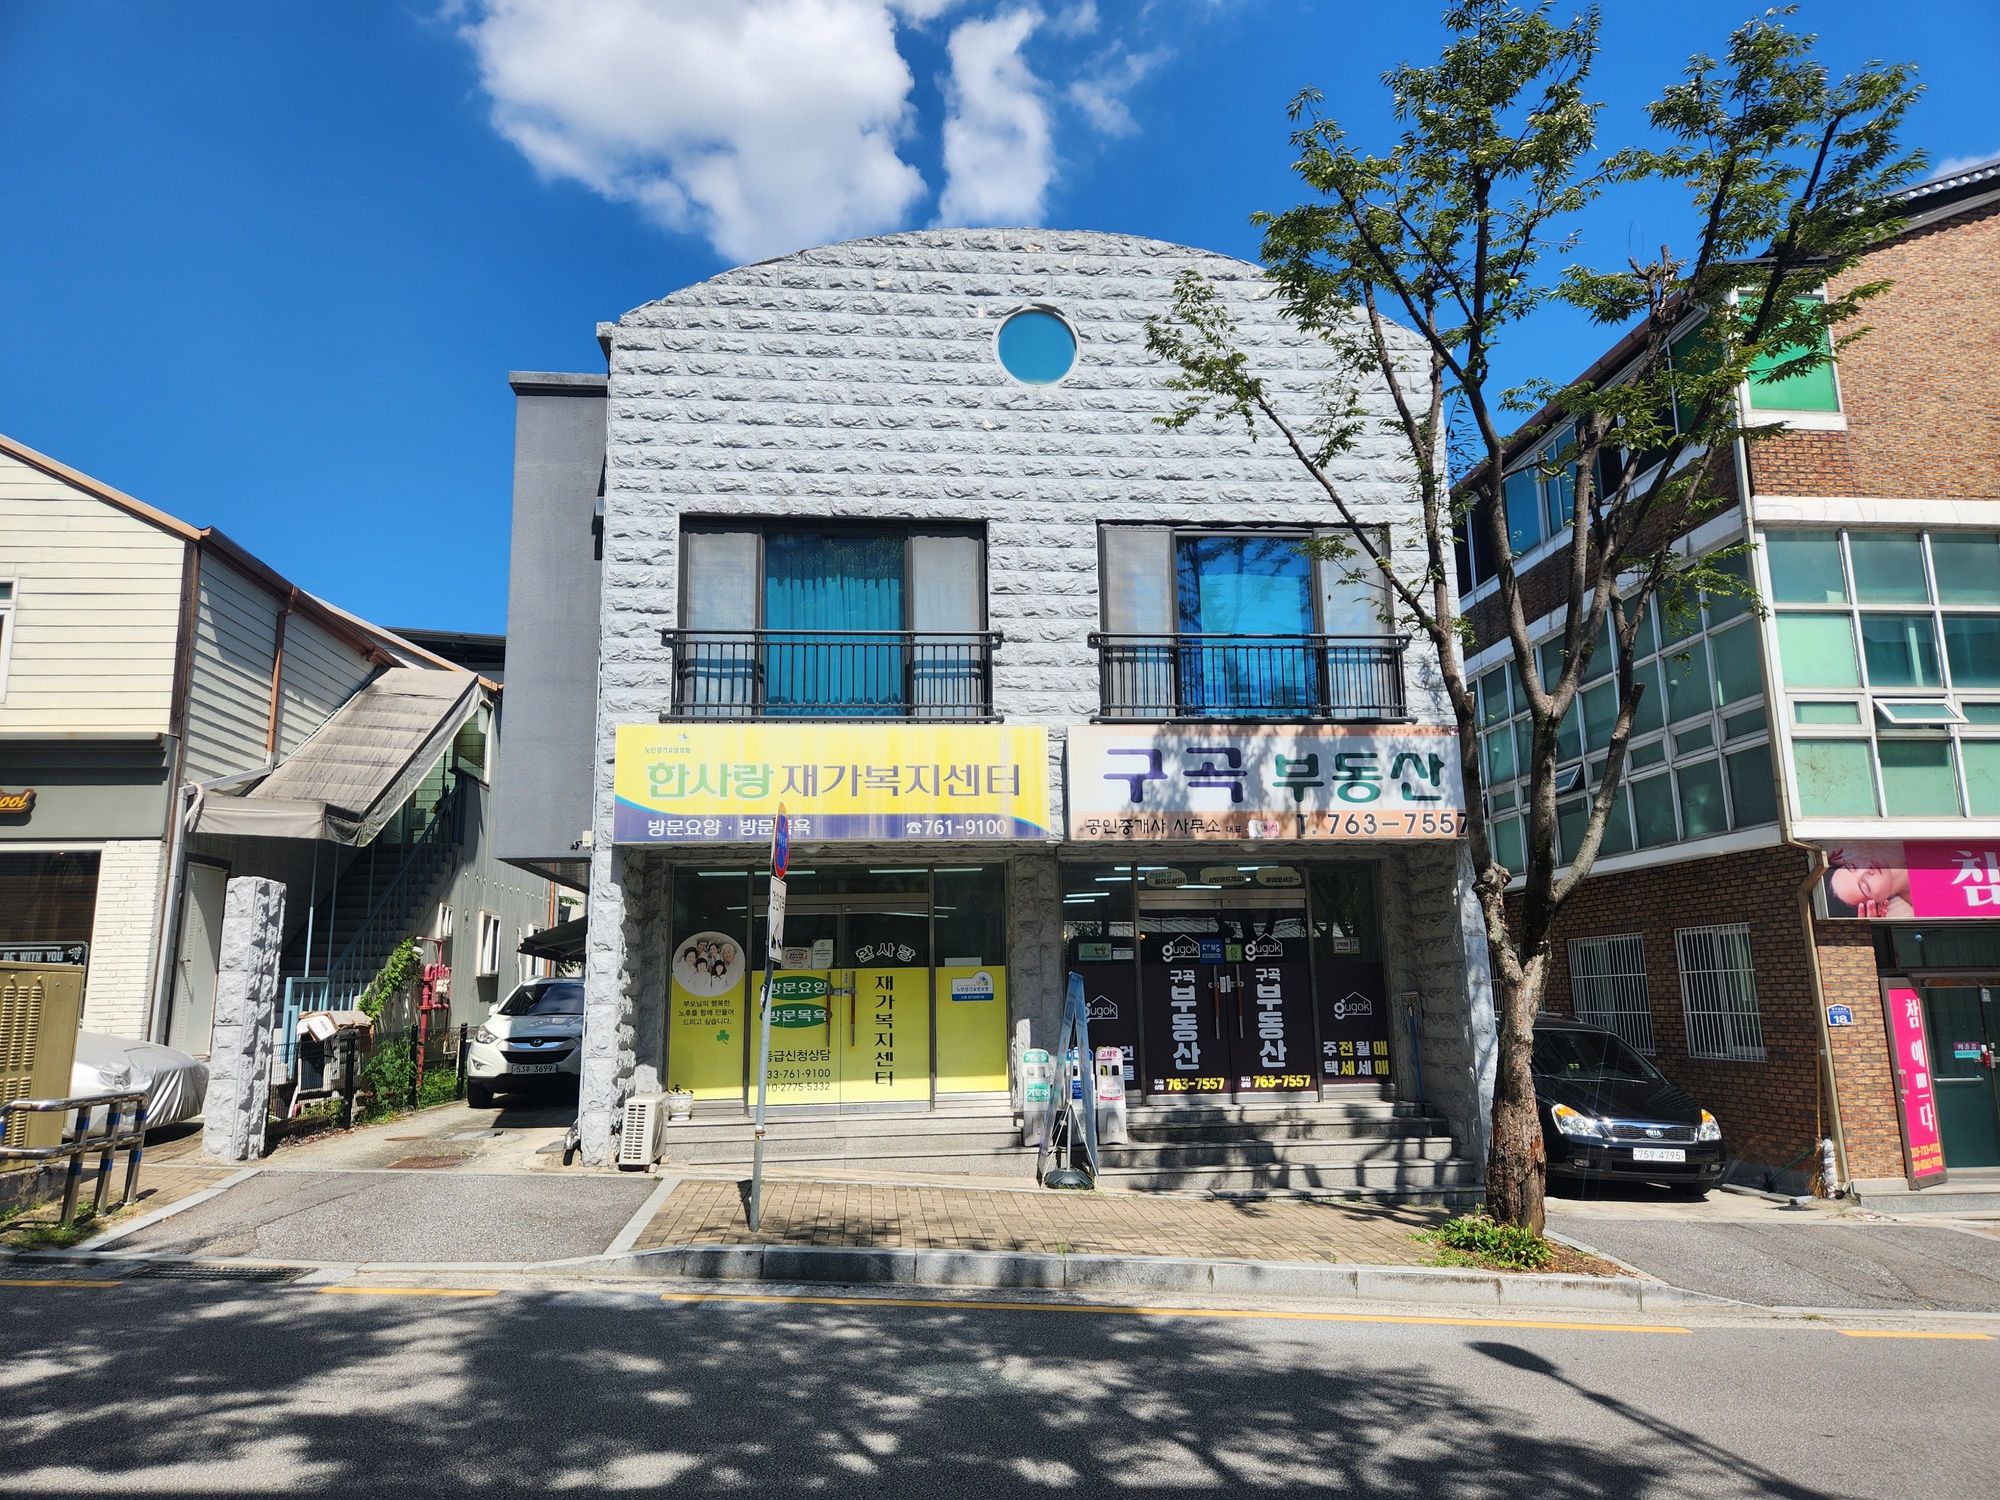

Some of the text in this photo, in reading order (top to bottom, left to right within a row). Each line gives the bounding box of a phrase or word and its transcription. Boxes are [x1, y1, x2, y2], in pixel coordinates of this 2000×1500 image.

[646, 762, 1020, 799] 한사랑 재가복지센터
[1103, 748, 1445, 803] 구곡 부동산
[647, 819, 722, 836] 방문요양
[923, 819, 1007, 835] 761-9100
[1086, 819, 1167, 834] 공인중개사
[1174, 818, 1221, 834] 사무소
[1327, 813, 1467, 835] 763-7557
[20, 951, 43, 962] WITH
[46, 951, 64, 962] YOU
[855, 943, 916, 963] 한사랑
[1162, 941, 1199, 962] gugok
[1245, 940, 1281, 961] gugok
[1170, 969, 1196, 984] 구곡
[1256, 968, 1281, 982] 구곡
[683, 1000, 709, 1008] 부모님의
[715, 1008, 734, 1016] 만들어
[1334, 999, 1370, 1020] gugok
[1833, 1015, 1848, 1024] 18
[1905, 999, 1920, 1029] 참
[874, 975, 895, 1086] 재가복지센터
[1170, 985, 1201, 1071] 부동산
[1256, 983, 1288, 1068] 부동산
[767, 1069, 831, 1080] 33-761-9100
[1253, 1074, 1311, 1089] 763-7557
[767, 1082, 830, 1092] 10-2775-5332
[1166, 1077, 1225, 1091] 763-7557
[1911, 1039, 1934, 1133] 예쁘다
[1659, 1151, 1681, 1160] 4795
